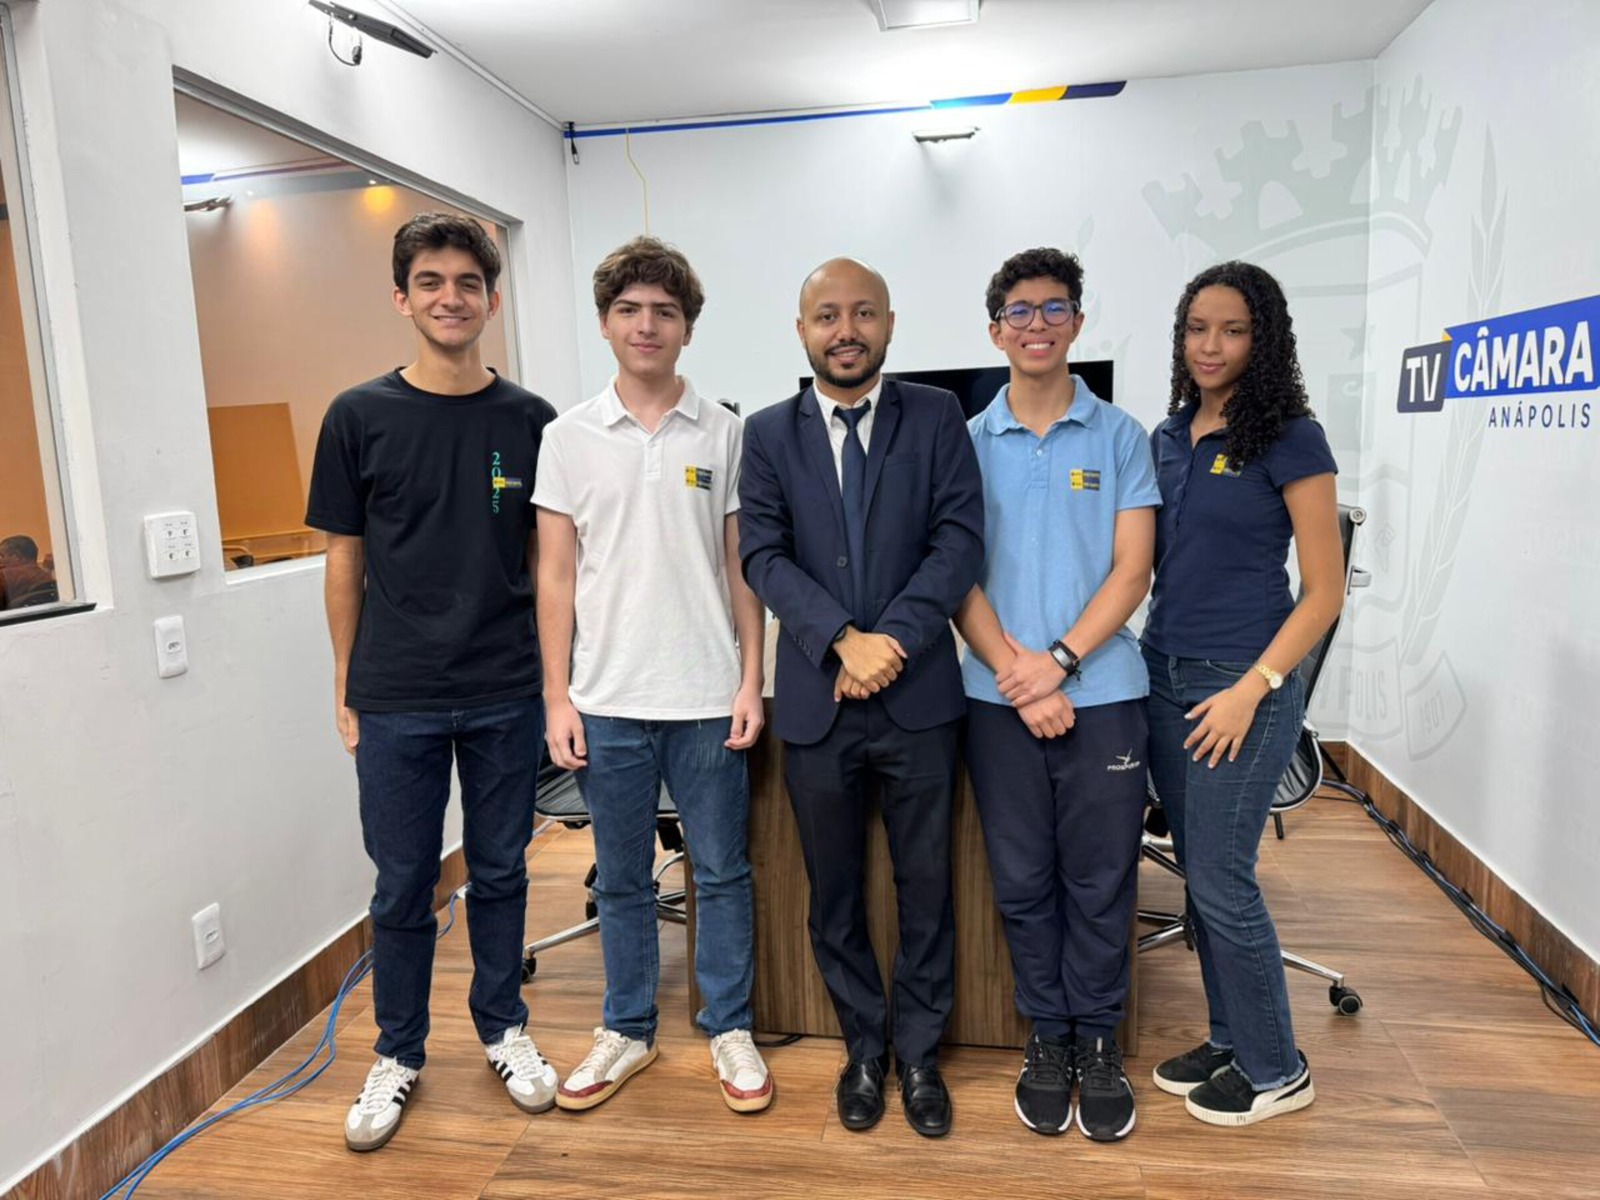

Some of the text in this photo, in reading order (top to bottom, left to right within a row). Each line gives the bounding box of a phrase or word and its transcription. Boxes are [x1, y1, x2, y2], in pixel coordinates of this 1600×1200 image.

[1406, 320, 1594, 403] TV CÂMARA
[1488, 402, 1591, 428] ANÁPOLIS
